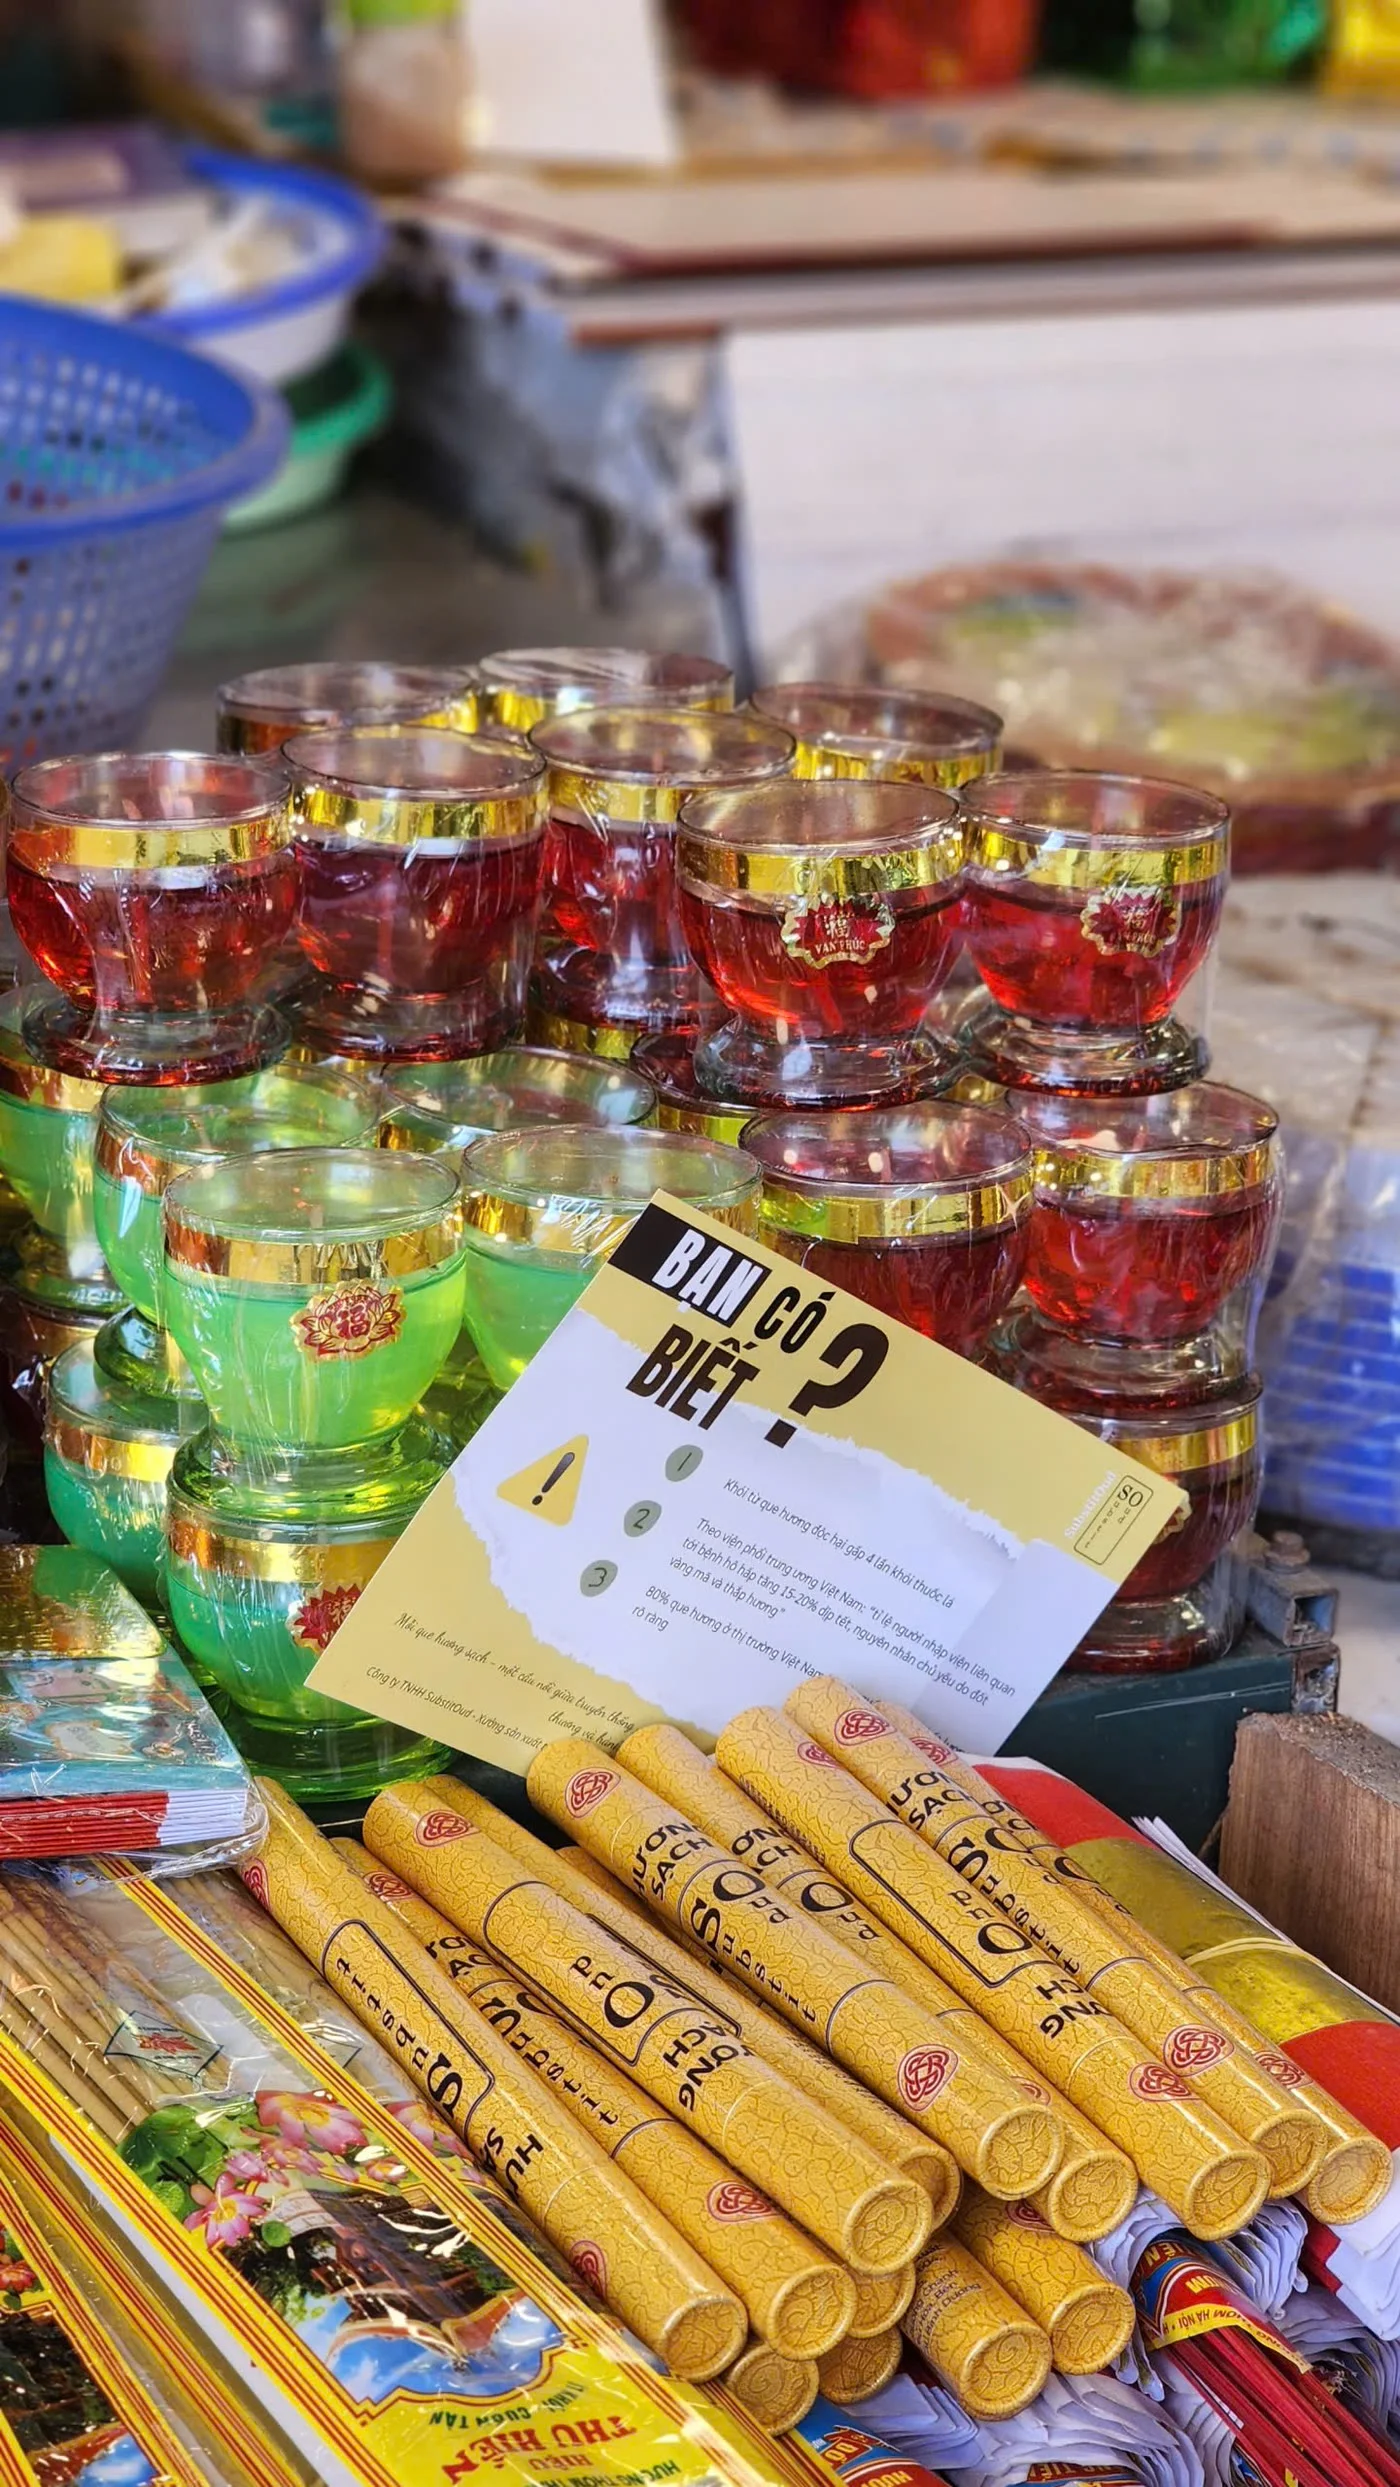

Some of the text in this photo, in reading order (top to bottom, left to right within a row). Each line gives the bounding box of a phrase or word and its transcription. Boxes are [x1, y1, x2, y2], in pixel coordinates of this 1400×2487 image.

[651, 1228, 836, 1354] BẠN CÓ
[335, 1302, 370, 1341] 福
[625, 1323, 890, 1448] BIẾT ?
[633, 1508, 650, 1530] 2
[586, 1565, 609, 1589] 3
[632, 1821, 704, 1900] HƯƠN
[652, 1838, 714, 1900] SẠCH
[549, 2414, 637, 2448] THU
